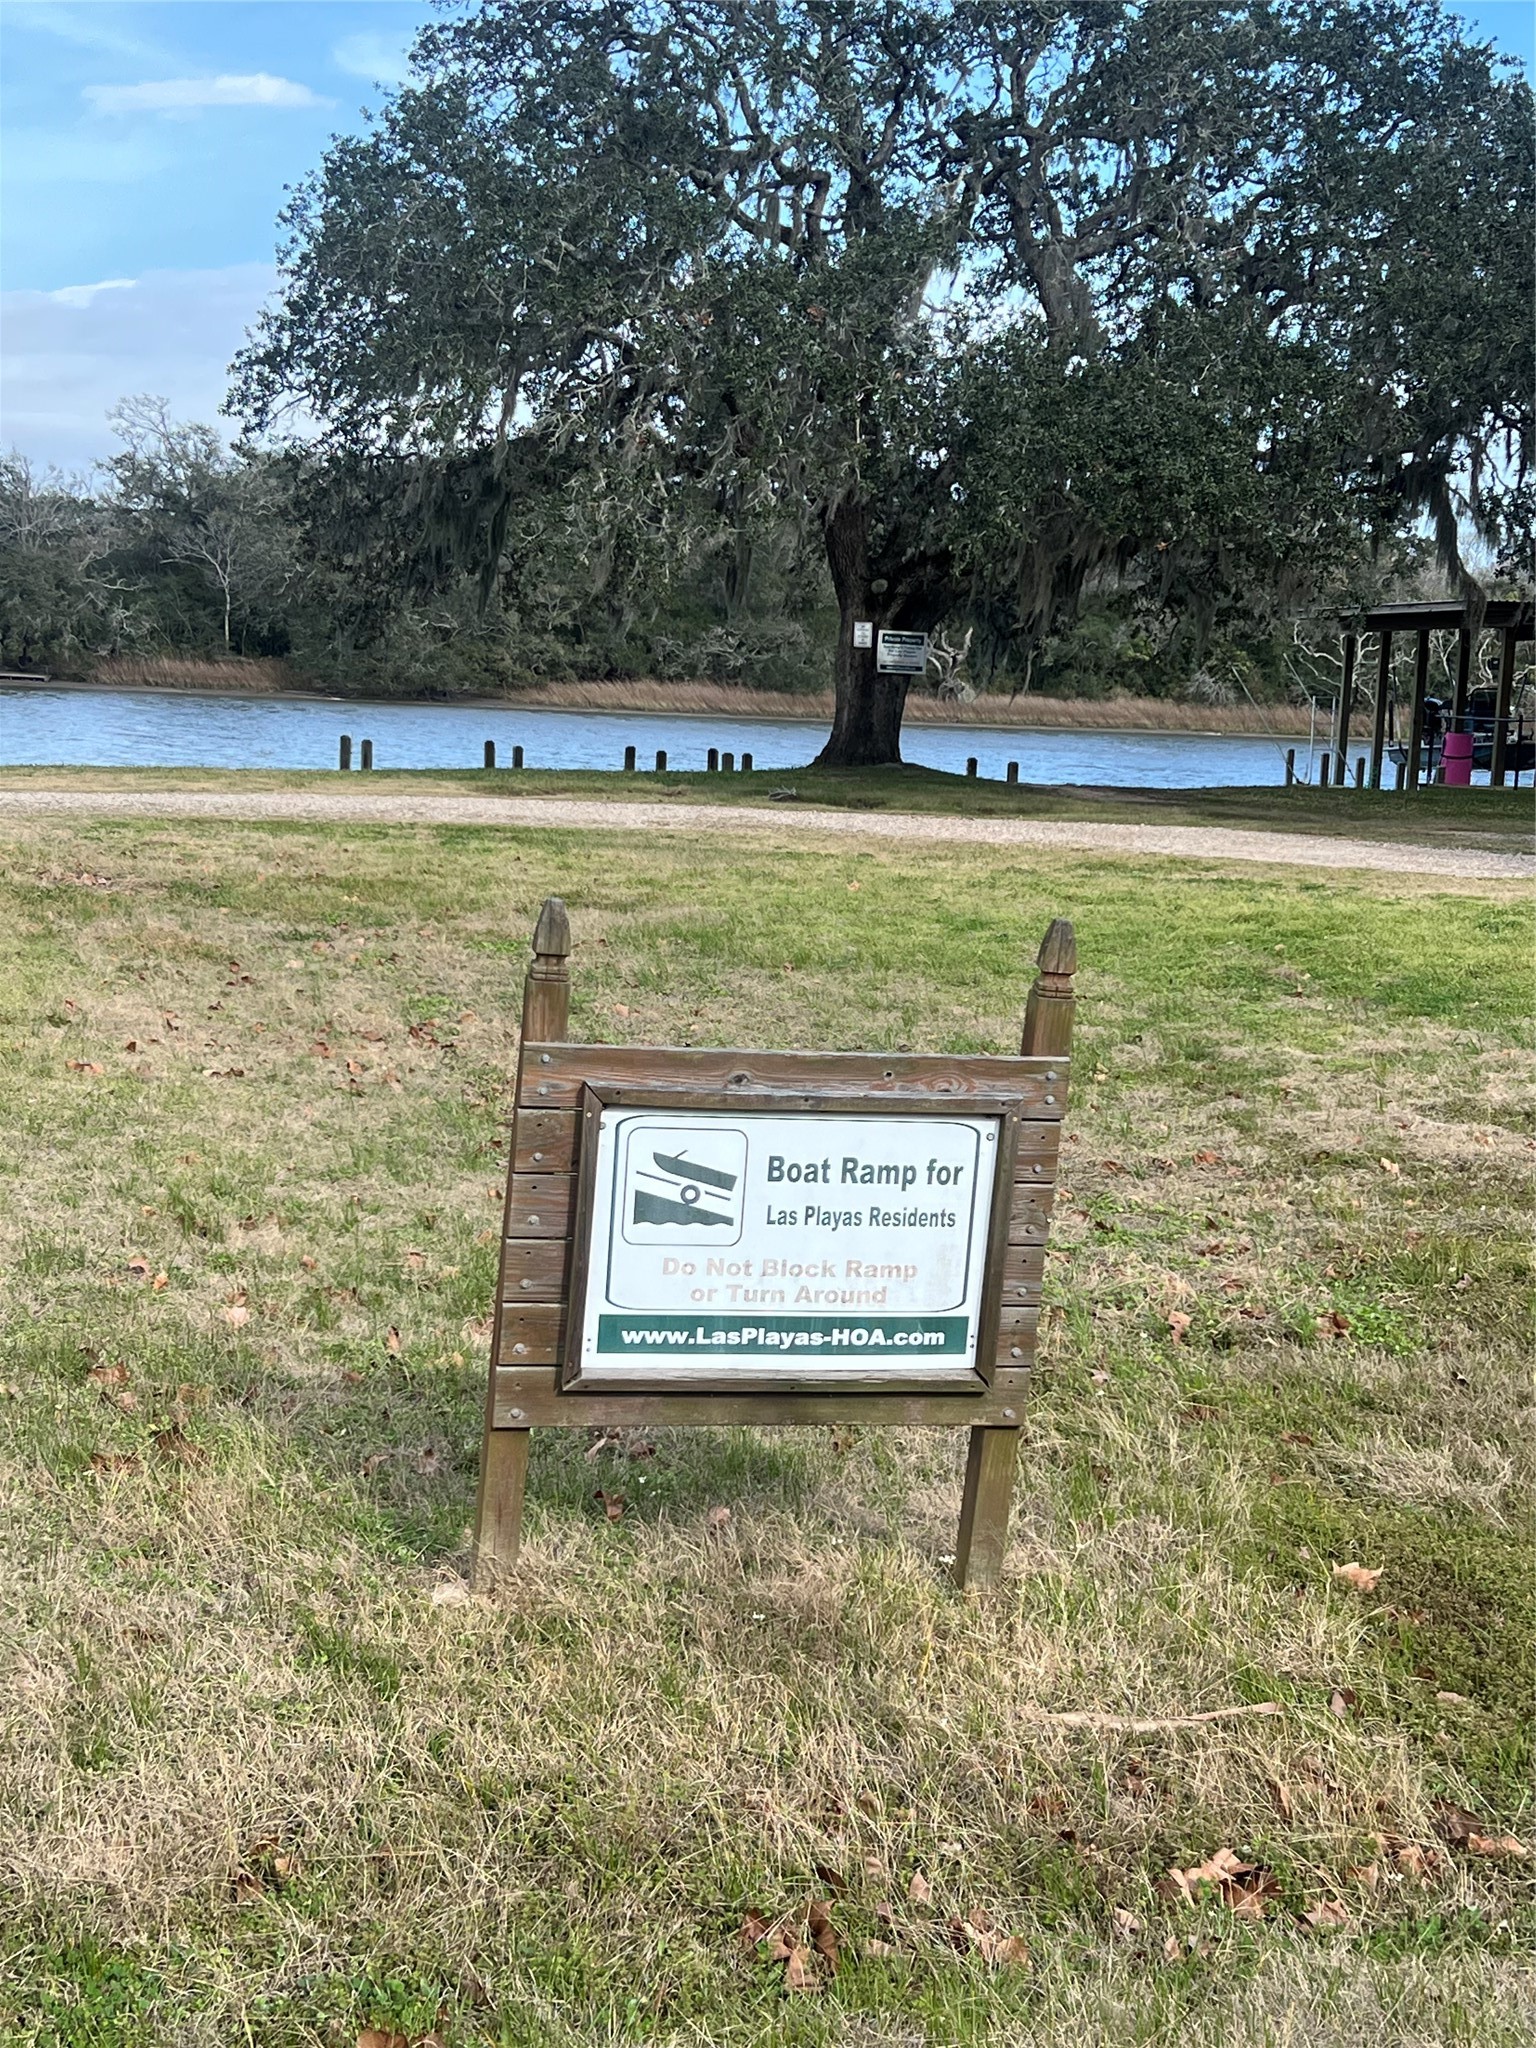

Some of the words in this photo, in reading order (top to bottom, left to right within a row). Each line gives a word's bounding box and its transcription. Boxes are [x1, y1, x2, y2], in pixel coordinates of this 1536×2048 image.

[767, 1155, 831, 1184] Boat
[841, 1156, 917, 1191] Ramp
[926, 1158, 964, 1186] for
[766, 1205, 798, 1226] Las
[804, 1205, 862, 1231] Playas
[869, 1206, 956, 1228] Residents
[662, 1257, 696, 1276] Do
[706, 1257, 752, 1278] Not
[761, 1258, 837, 1278] Block
[845, 1259, 918, 1282] Ramp
[689, 1286, 718, 1303] or
[725, 1284, 785, 1304] Turn
[794, 1285, 887, 1305] Around
[621, 1325, 946, 1351] www.LasPlayas-HOA.com
